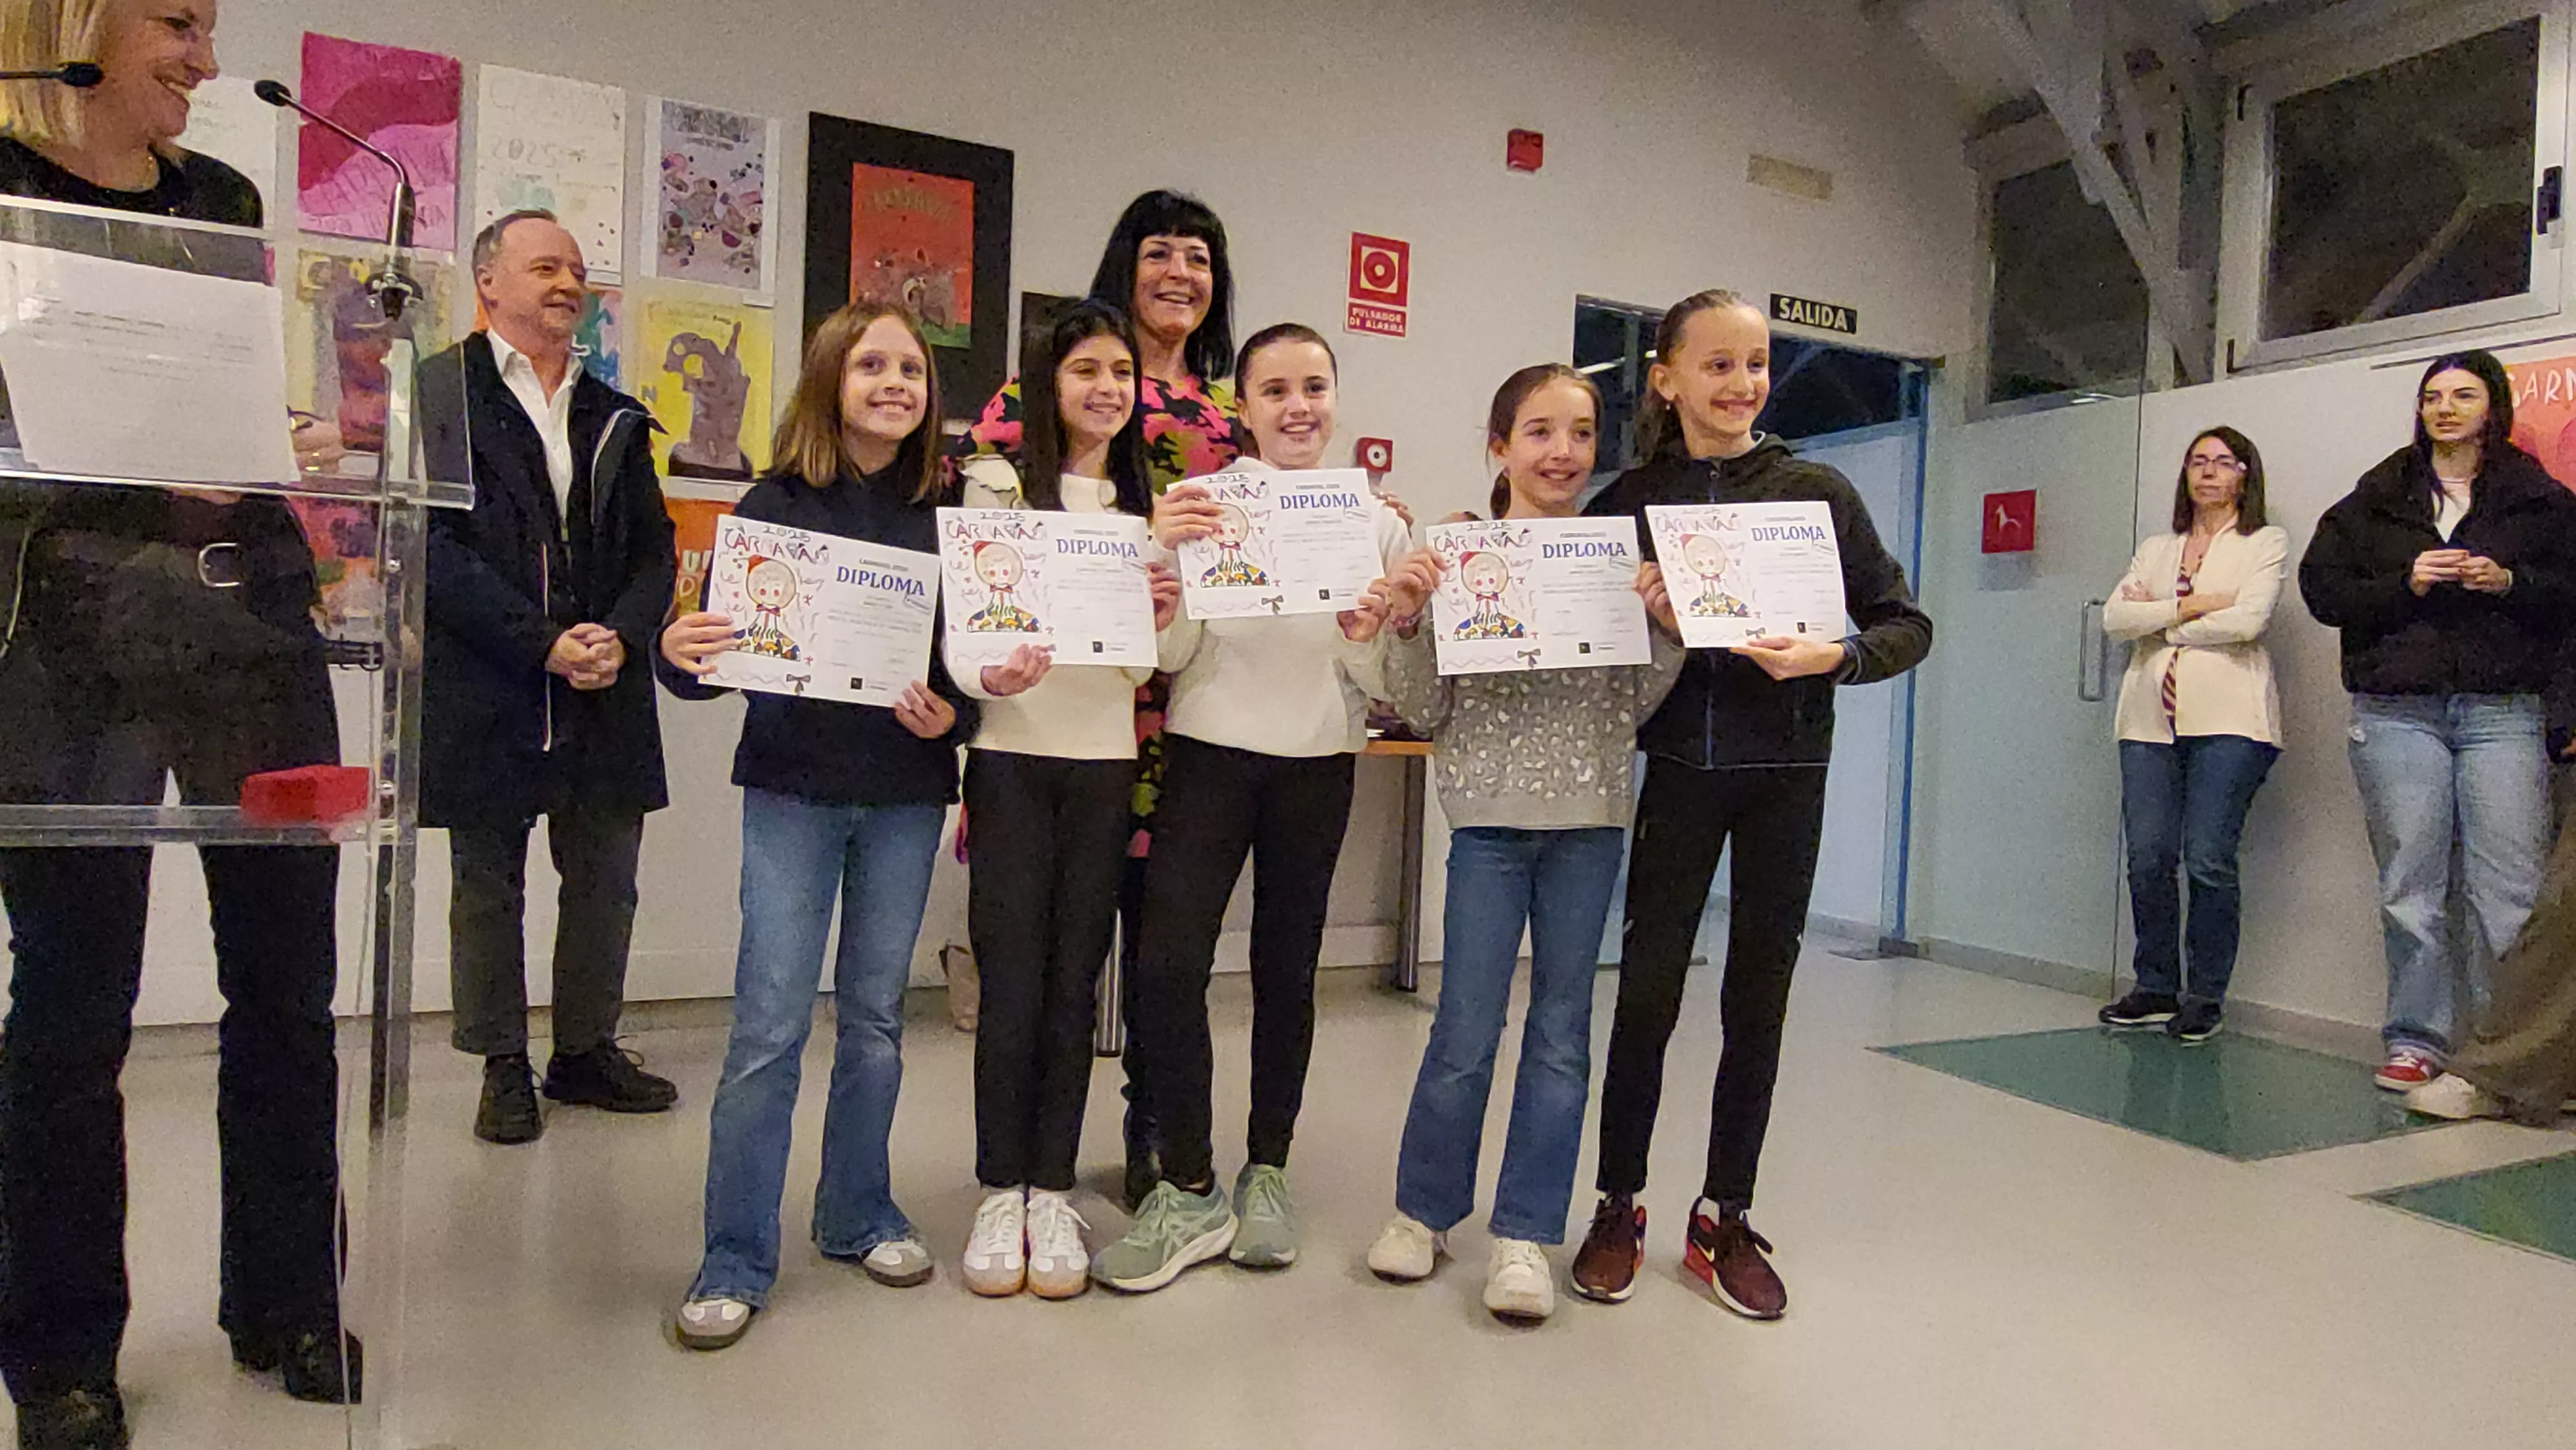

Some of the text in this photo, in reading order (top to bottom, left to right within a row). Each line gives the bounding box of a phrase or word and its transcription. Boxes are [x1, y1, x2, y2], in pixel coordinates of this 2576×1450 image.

[1352, 307, 1402, 323] PULSADOR
[1779, 297, 1848, 331] SALIDA
[1365, 319, 1404, 334] ALARMA
[1279, 493, 1361, 509] DIPLOMA
[762, 525, 811, 543] 2025
[1750, 526, 1827, 541] DIPLOMA
[1056, 538, 1139, 559] DIPLOMA
[1542, 542, 1628, 559] DIPLOMA
[836, 565, 926, 597] DIPLOMA
